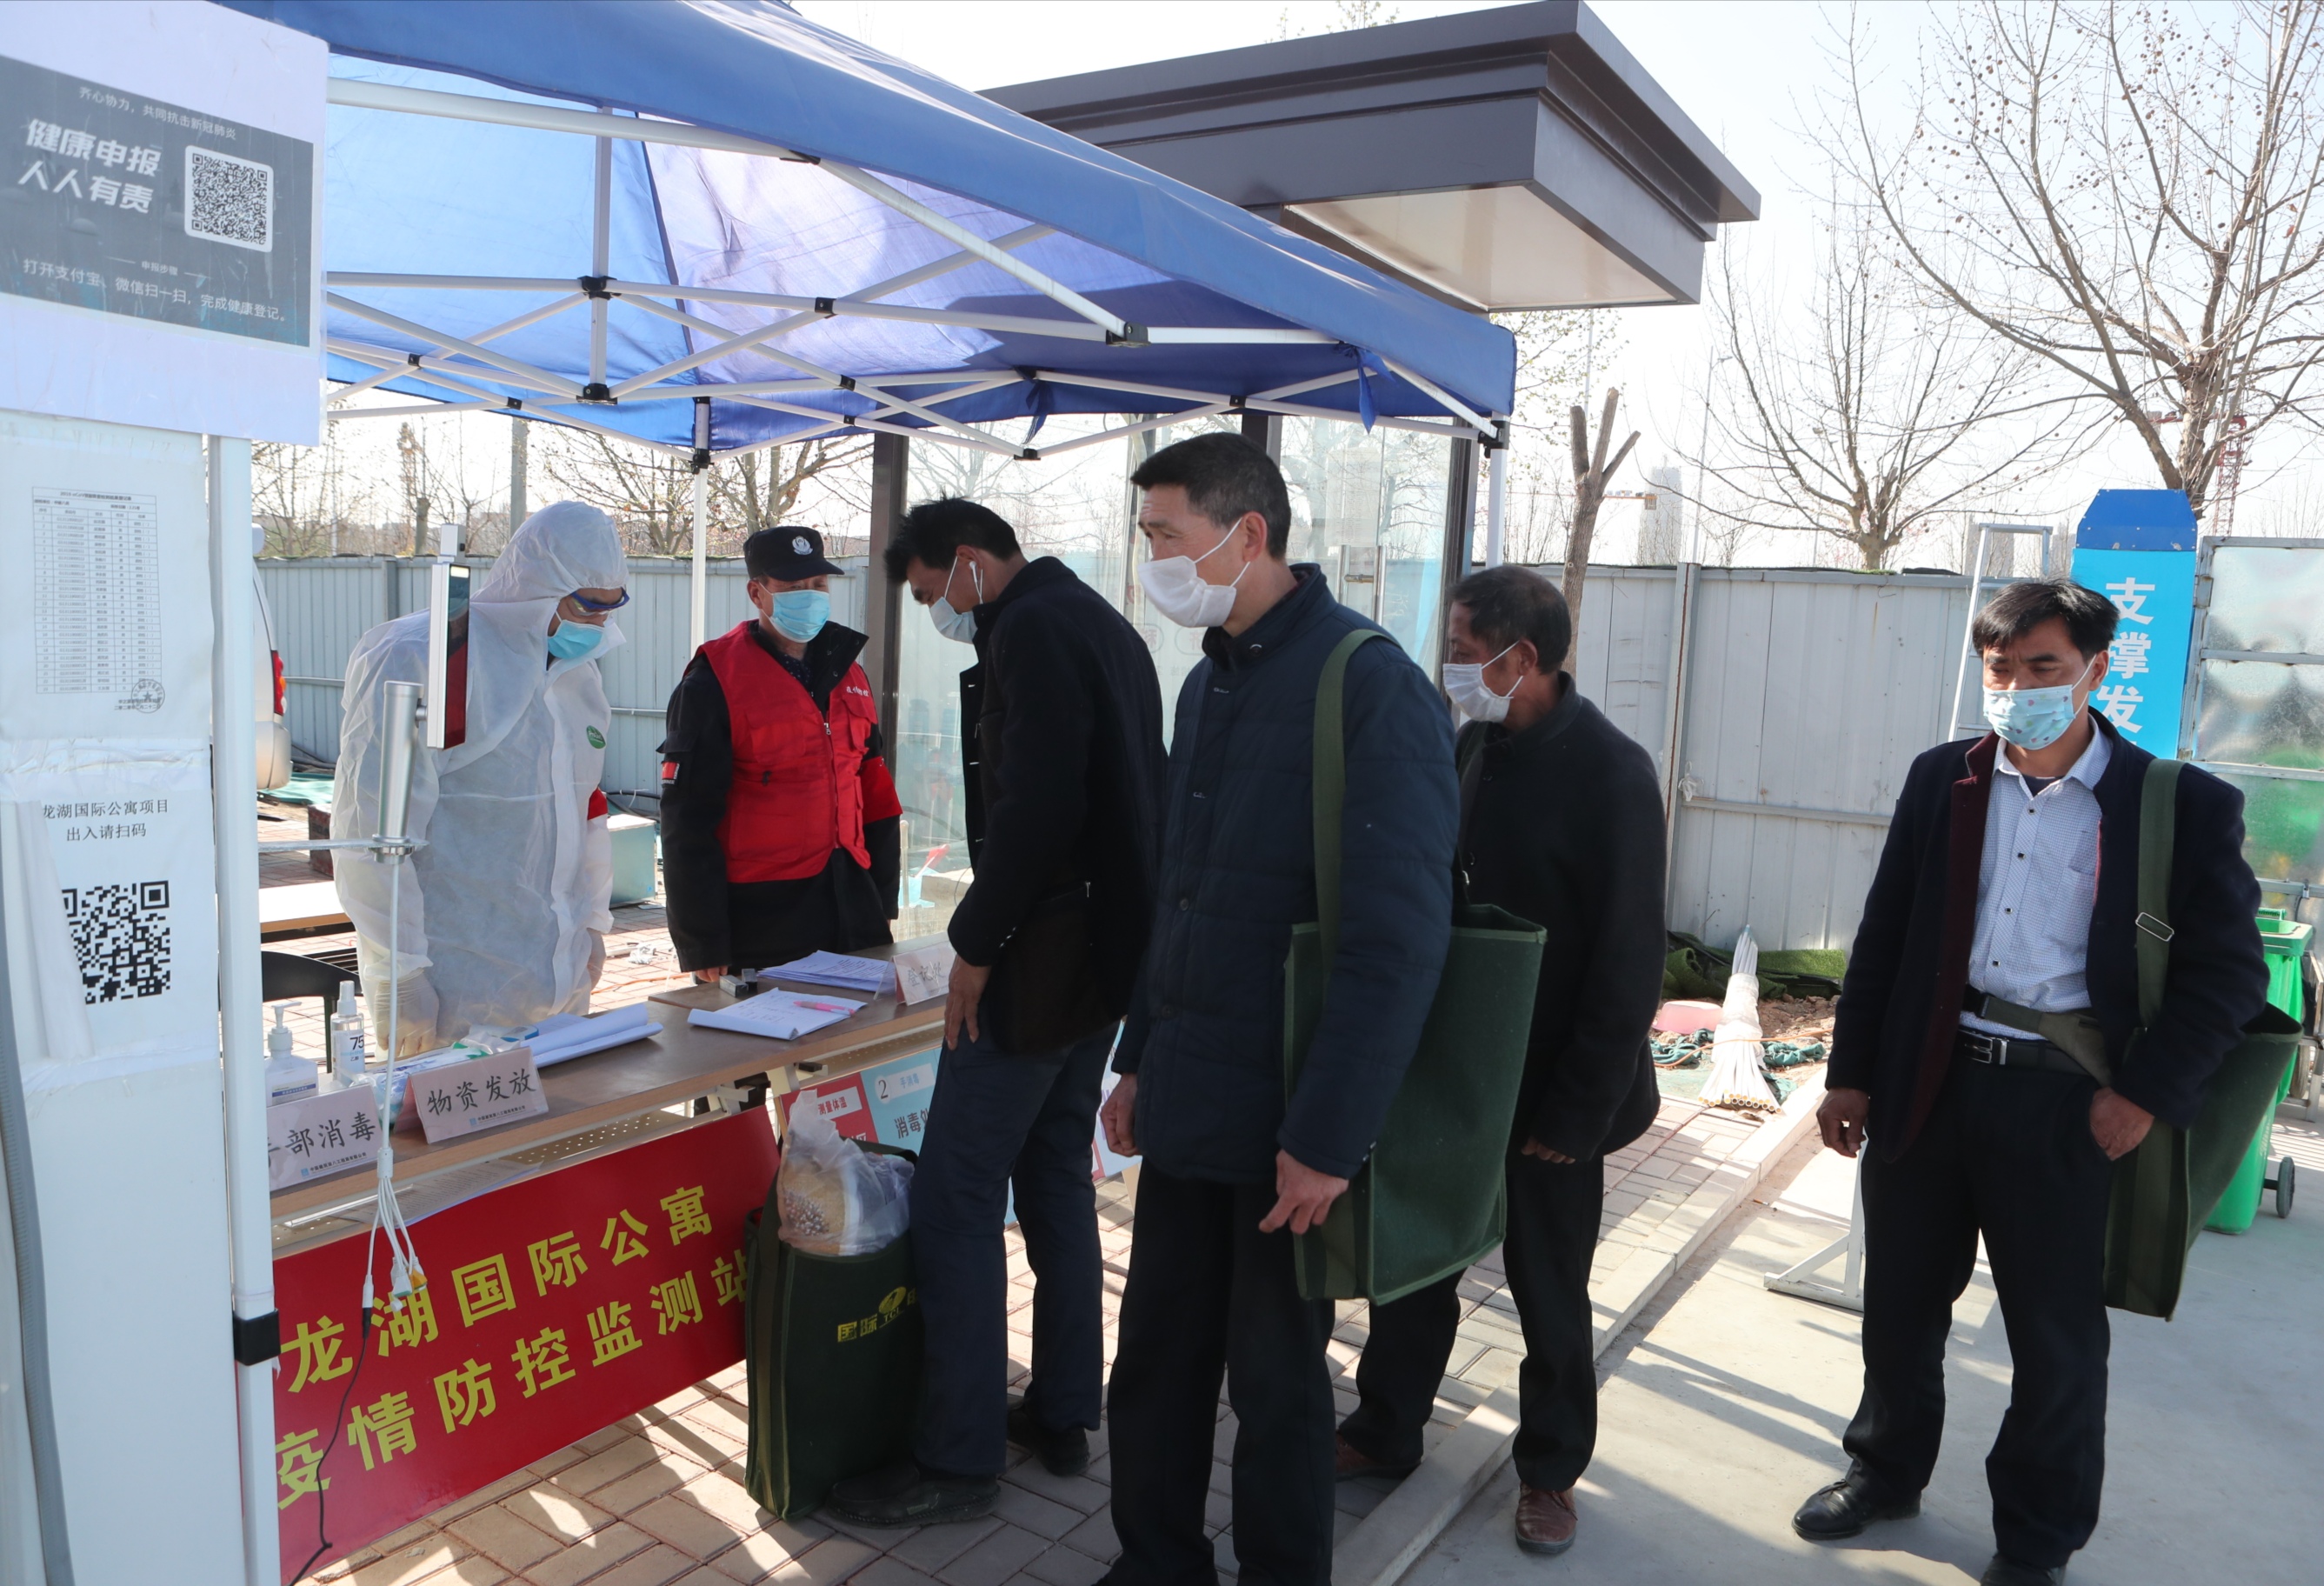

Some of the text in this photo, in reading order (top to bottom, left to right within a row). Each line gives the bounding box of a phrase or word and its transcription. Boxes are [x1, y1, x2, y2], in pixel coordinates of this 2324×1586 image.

[25, 118, 163, 177] 健康申报
[17, 160, 155, 215] 人人有责
[2096, 576, 2155, 745] 支撑发
[43, 798, 169, 820] 龙湖国际公寓项目
[66, 823, 147, 842] 出入请扫码
[427, 1068, 536, 1116] 物资发放
[817, 1096, 848, 1116] 测量体温
[878, 1079, 889, 1100] 2
[280, 1184, 713, 1395] 龙湖国际公寓
[276, 1249, 748, 1510] 疫情防控监测站
